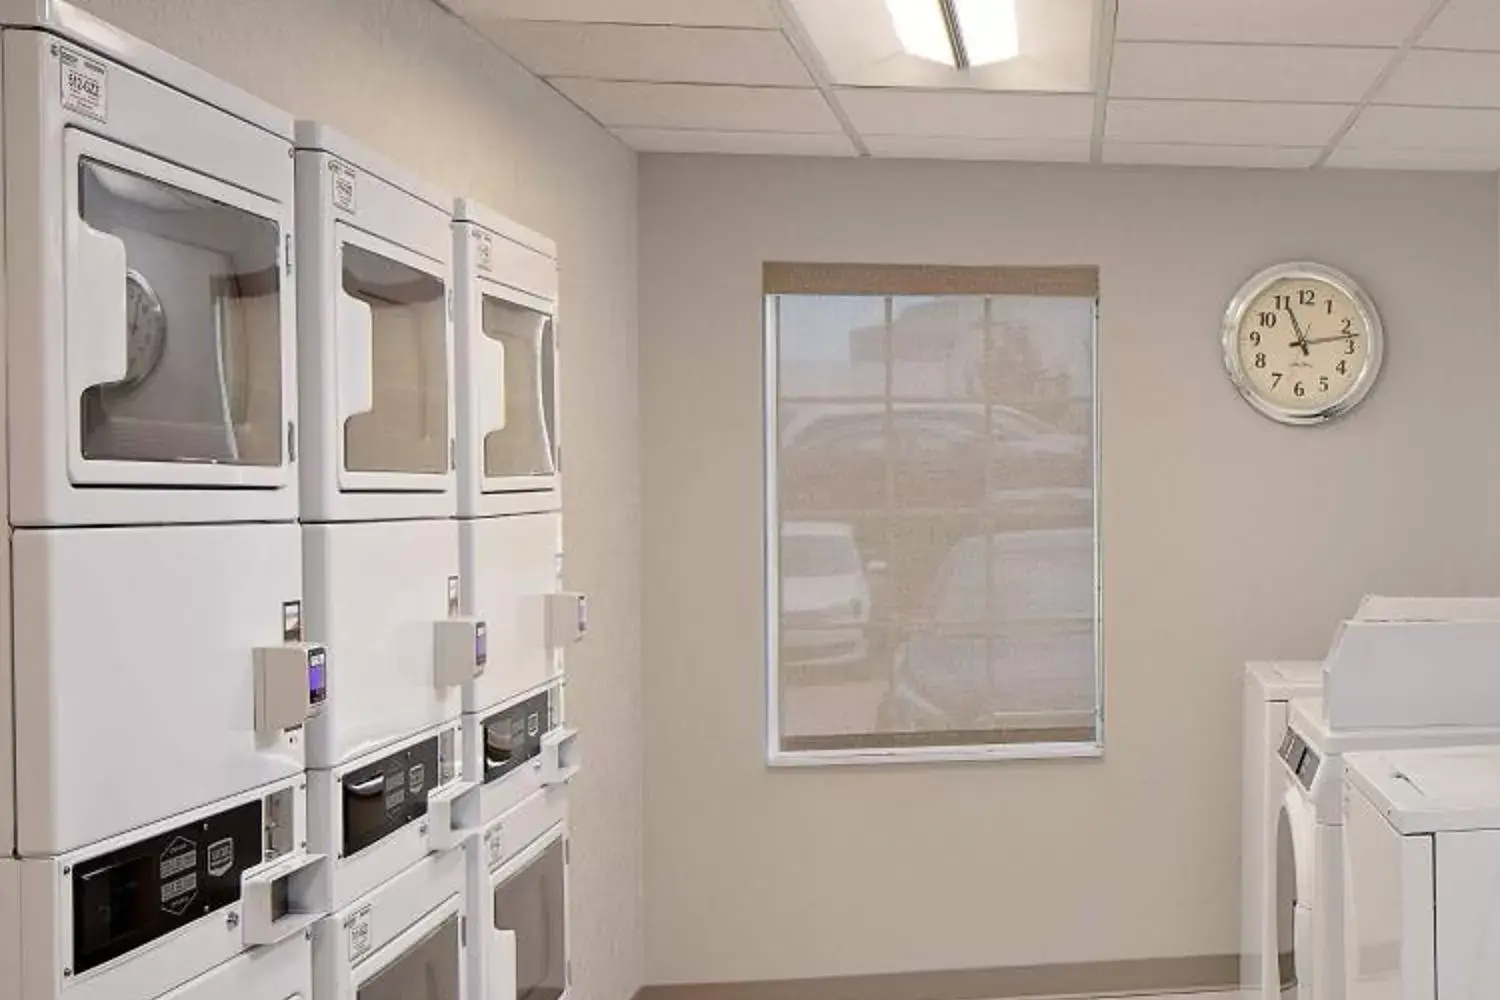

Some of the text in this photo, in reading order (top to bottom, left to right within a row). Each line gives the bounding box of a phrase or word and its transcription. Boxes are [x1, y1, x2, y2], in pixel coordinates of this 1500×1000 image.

[1274, 295, 1291, 310] 11
[1296, 290, 1315, 305] 12
[1325, 298, 1333, 314] 1
[1258, 312, 1277, 328] 10
[1341, 319, 1352, 334] 2
[1249, 332, 1261, 346] 9
[1344, 340, 1355, 355] 3
[1255, 354, 1267, 368] 8
[1335, 360, 1347, 375] 4
[1271, 373, 1283, 391] 7
[1294, 381, 1305, 397] 6
[1319, 376, 1329, 392] 5
